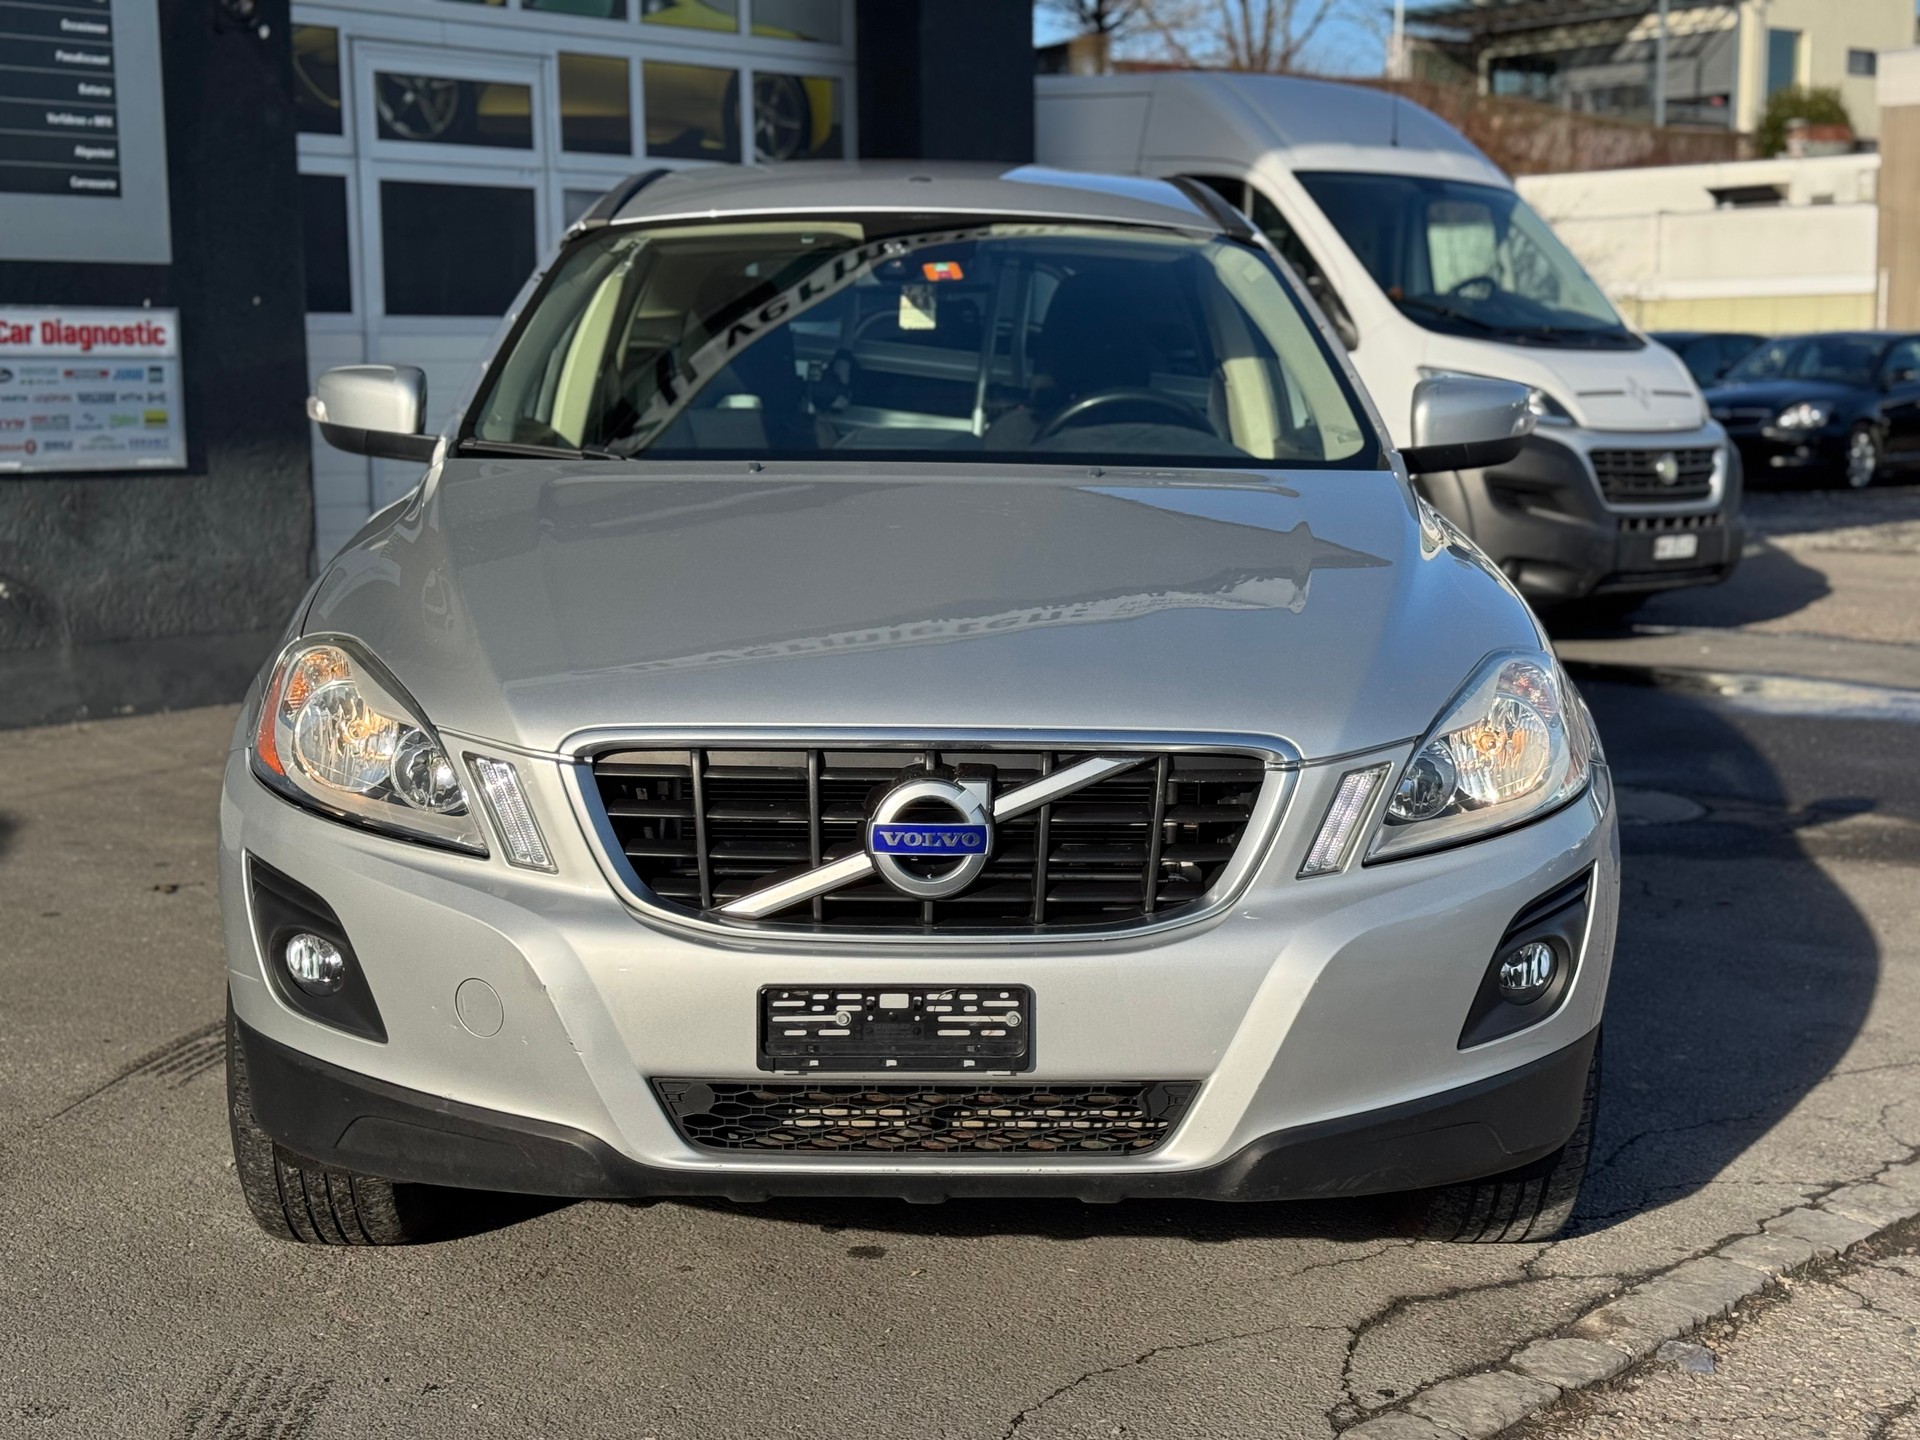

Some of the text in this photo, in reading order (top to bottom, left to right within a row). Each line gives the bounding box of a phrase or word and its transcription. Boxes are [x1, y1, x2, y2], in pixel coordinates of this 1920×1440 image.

[0, 319, 166, 352] Car Diagnostic
[879, 831, 981, 847] VOLVO
